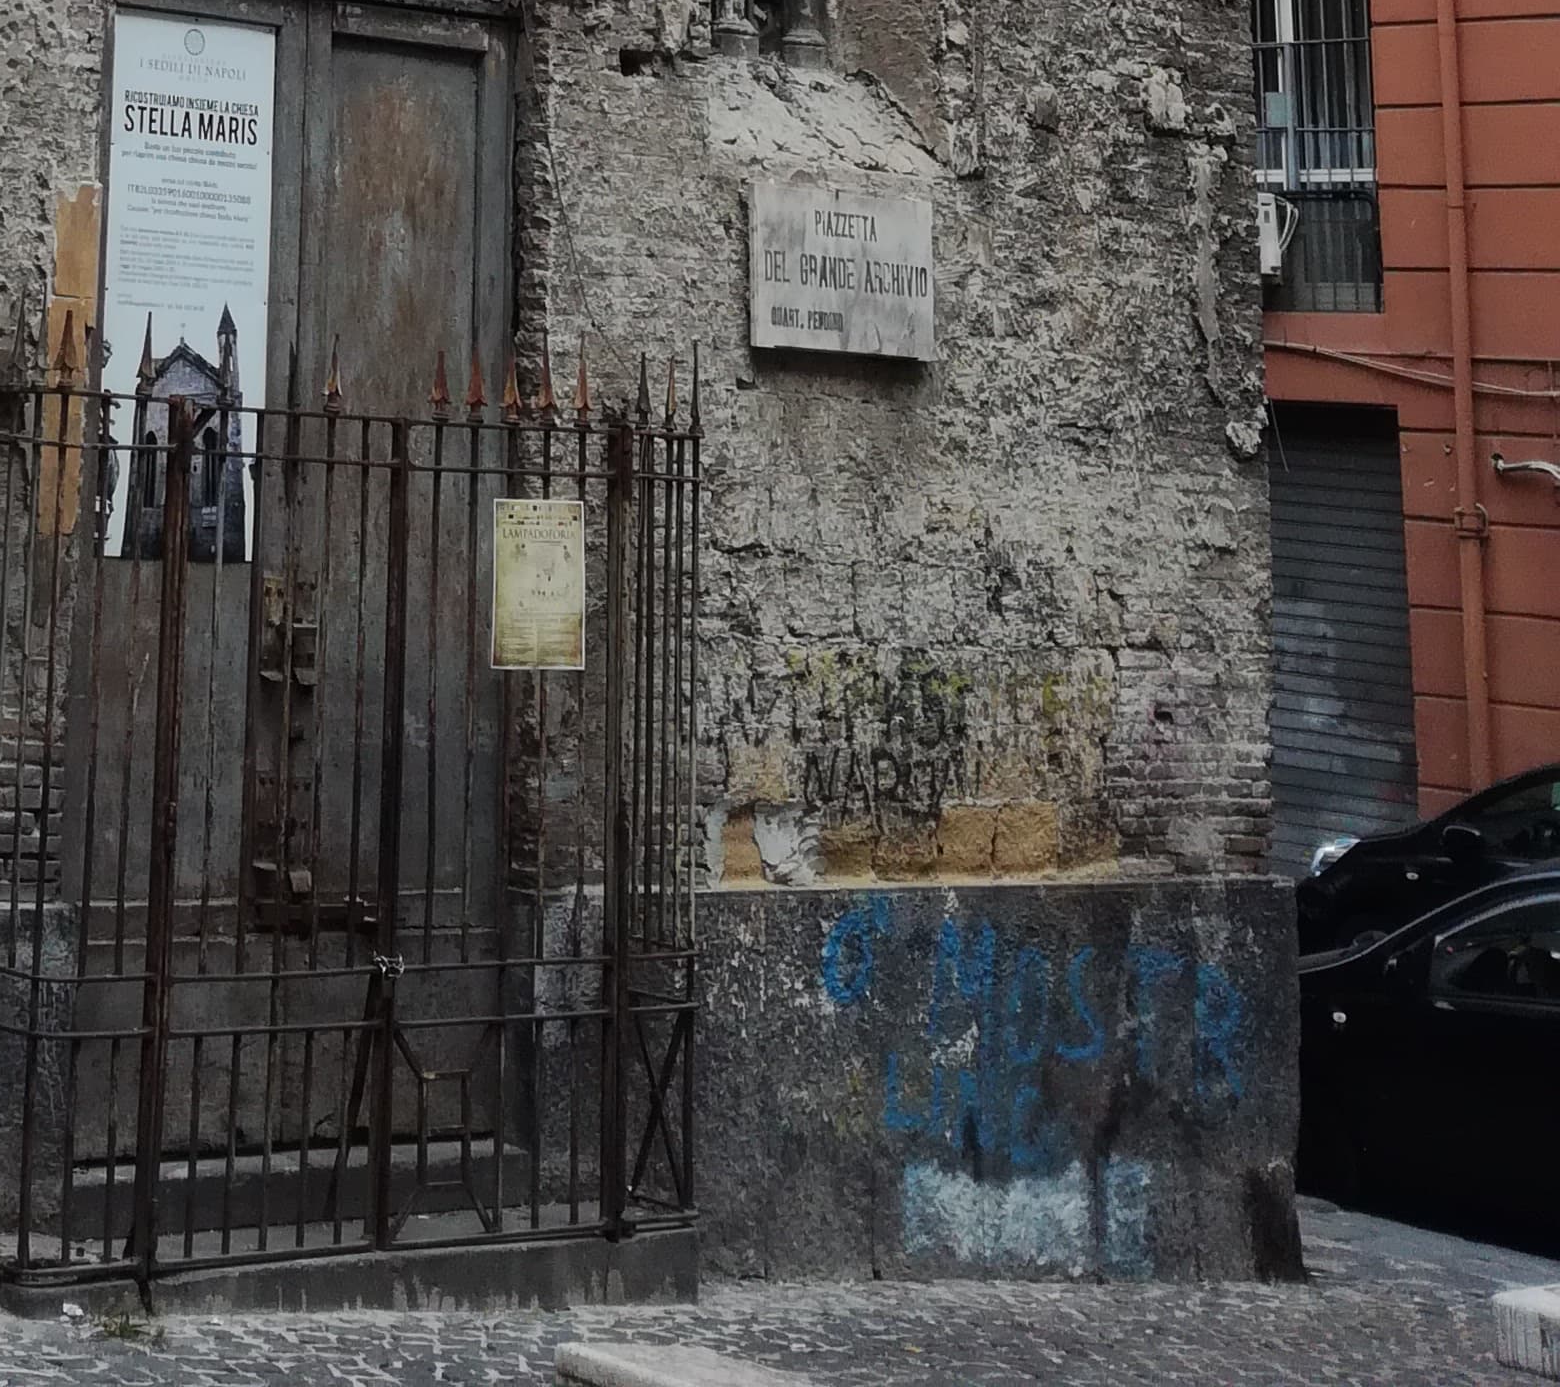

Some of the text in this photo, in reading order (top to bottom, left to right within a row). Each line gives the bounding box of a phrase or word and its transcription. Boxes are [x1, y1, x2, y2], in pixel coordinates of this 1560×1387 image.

[148, 59, 184, 74] SEDILI
[205, 66, 247, 81] NAPOLI
[124, 90, 259, 117] RICOSTRUIAMO INSIEME LA CHIESA
[123, 104, 258, 146] STELLA MARIS
[814, 208, 878, 243] PIAZZETTA
[763, 249, 928, 298] DEL GRANDE ARCHIVIO
[771, 306, 805, 330] QUART.
